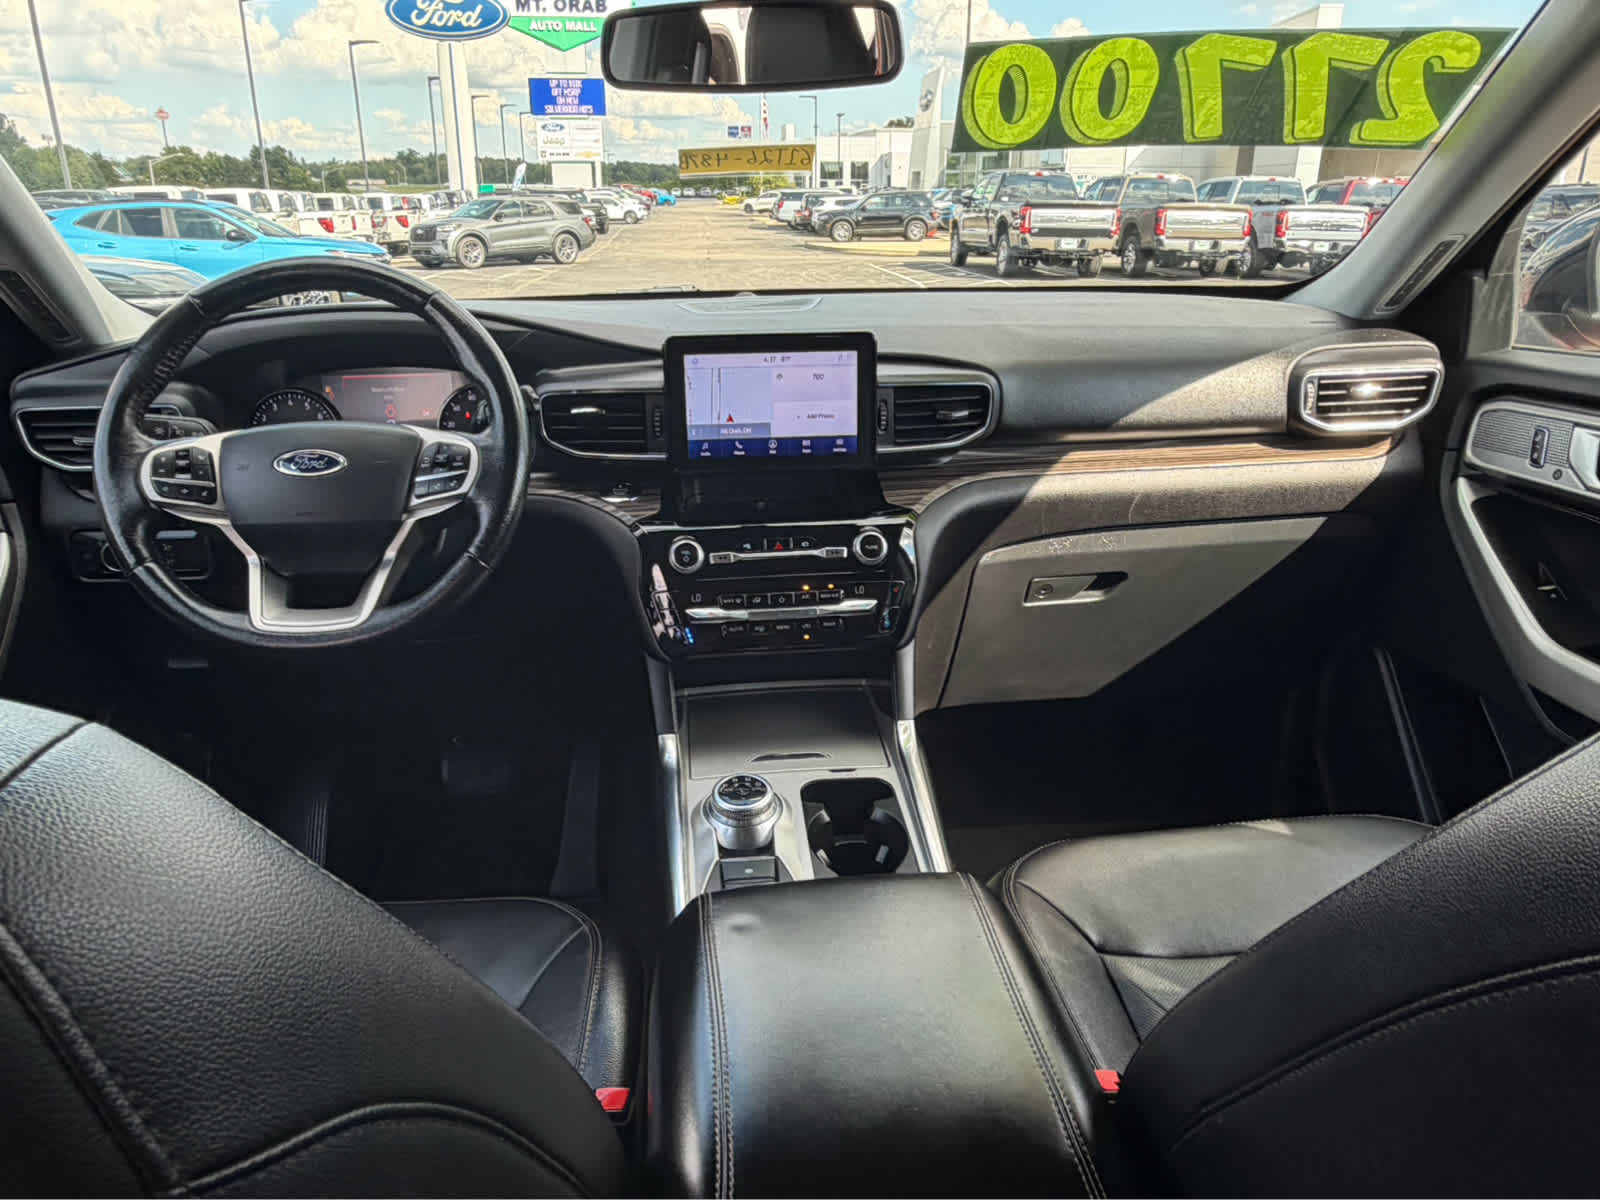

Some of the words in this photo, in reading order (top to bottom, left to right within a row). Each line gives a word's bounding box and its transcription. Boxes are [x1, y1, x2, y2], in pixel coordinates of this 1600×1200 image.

[515, 0, 547, 13] MT.
[557, 0, 608, 13] ORAB
[411, 0, 483, 28] Ford
[529, 20, 563, 33] AUTO
[566, 20, 598, 33] MALL
[291, 455, 329, 470] Ford
